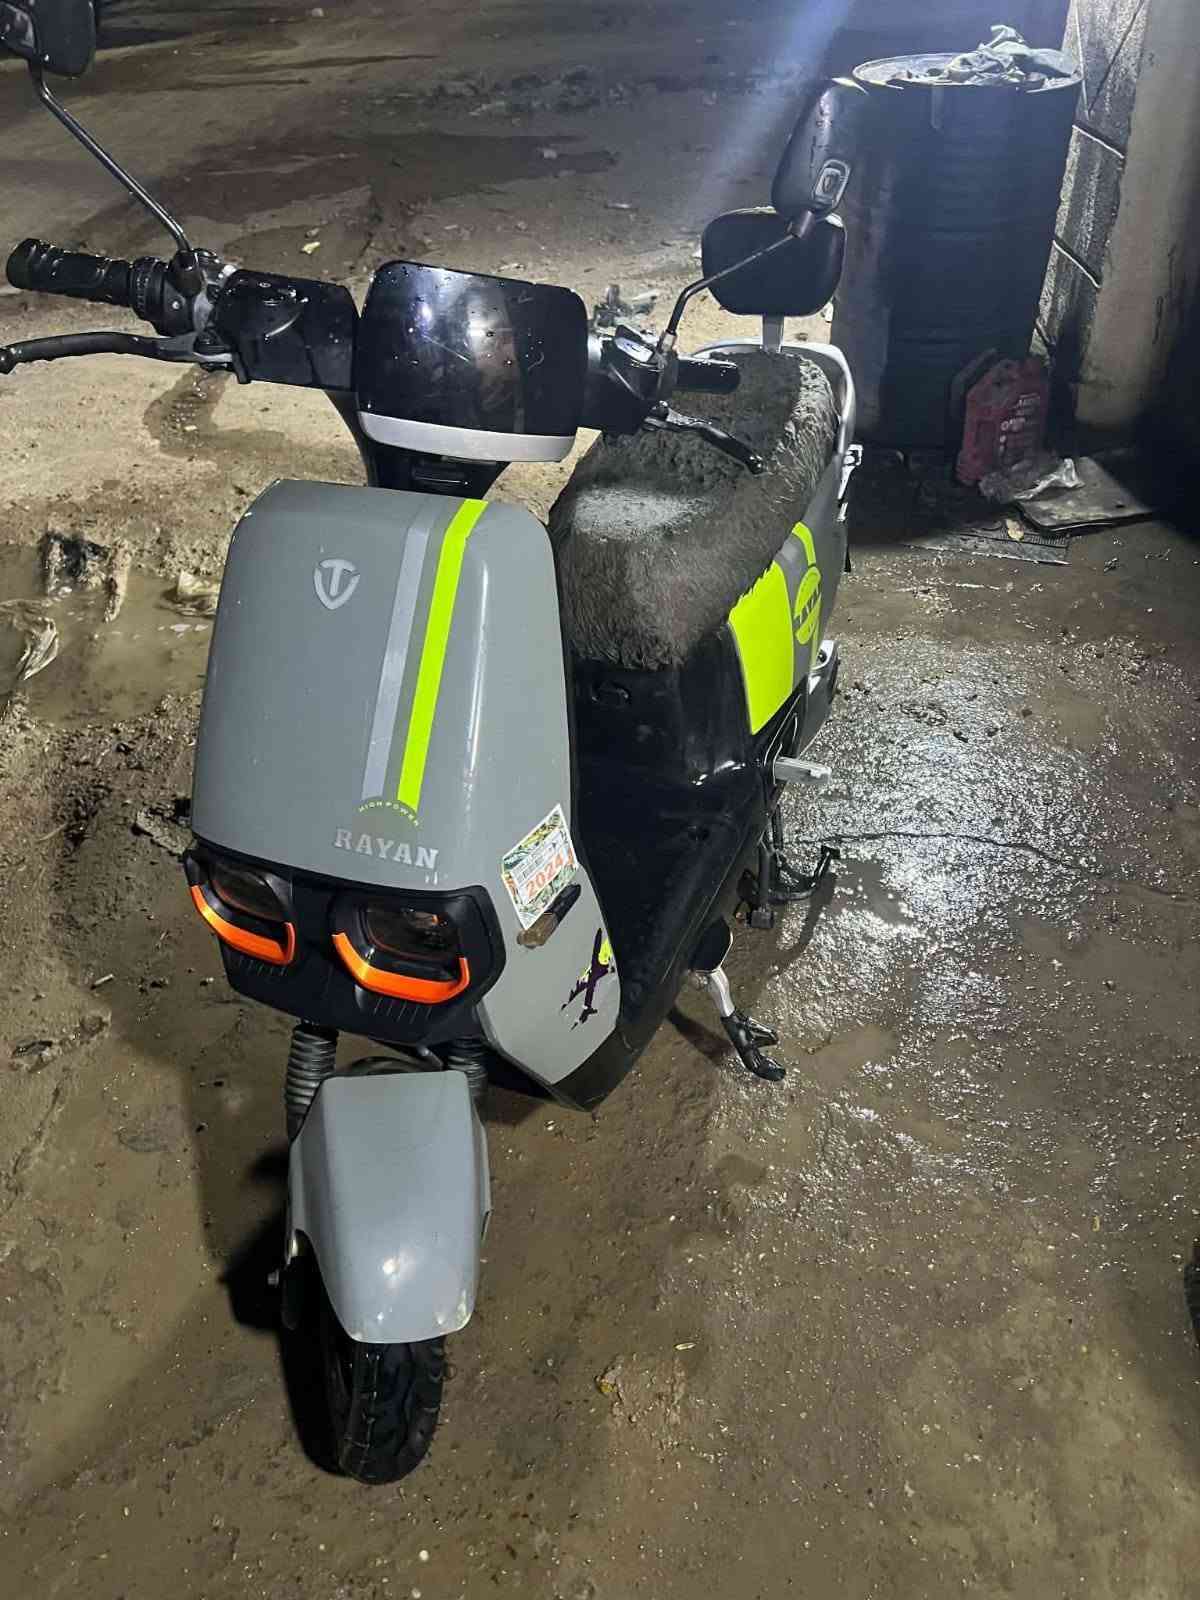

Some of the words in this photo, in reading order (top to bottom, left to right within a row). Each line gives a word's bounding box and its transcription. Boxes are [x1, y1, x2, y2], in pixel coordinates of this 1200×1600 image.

[358, 800, 384, 813] HIGH
[334, 828, 439, 869] RAYAN
[525, 852, 565, 898] 2024
